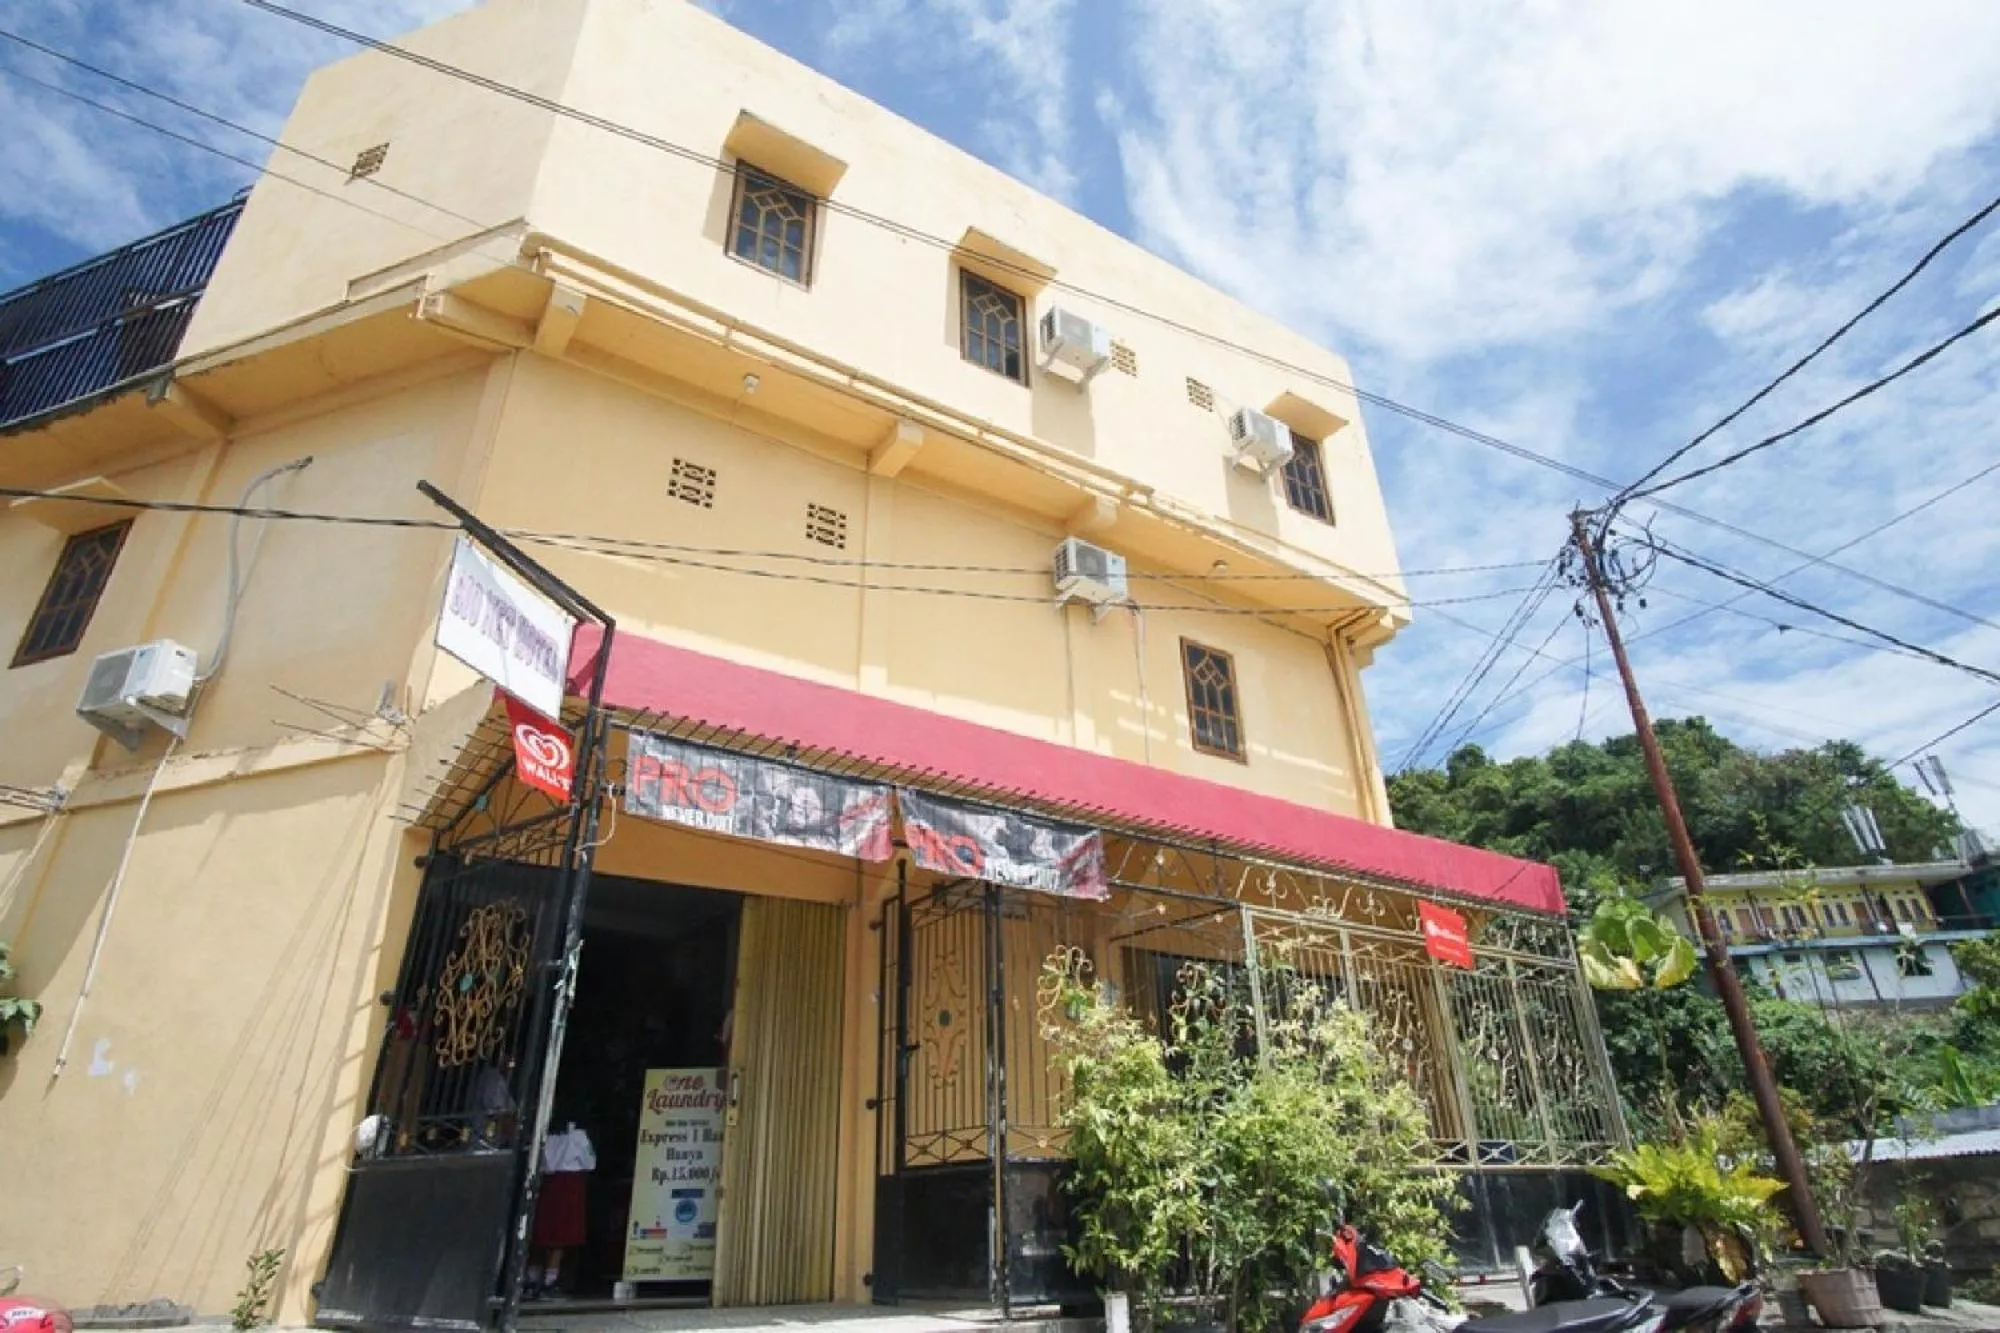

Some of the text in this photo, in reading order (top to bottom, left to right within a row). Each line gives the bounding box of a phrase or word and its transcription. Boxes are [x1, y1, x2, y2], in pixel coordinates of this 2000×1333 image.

[633, 755, 737, 813] PRO
[646, 1088, 727, 1115] Laundry
[640, 1129, 687, 1147] Express
